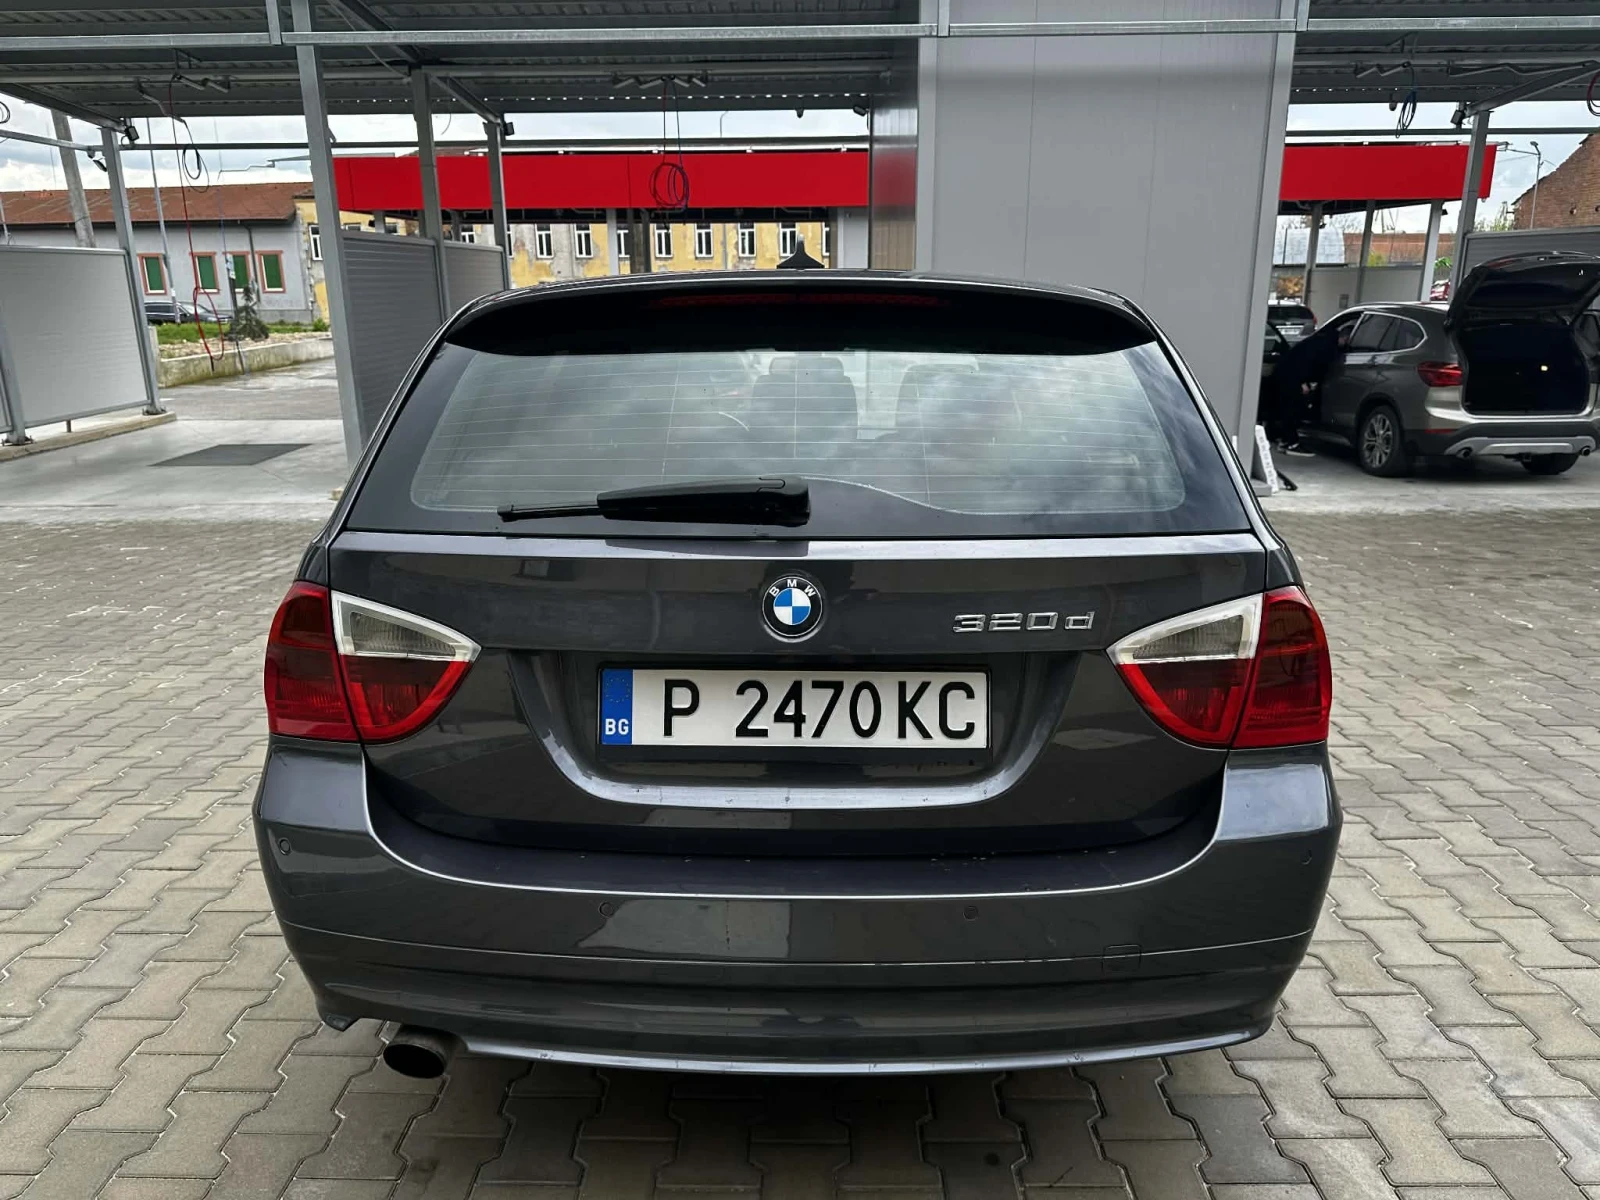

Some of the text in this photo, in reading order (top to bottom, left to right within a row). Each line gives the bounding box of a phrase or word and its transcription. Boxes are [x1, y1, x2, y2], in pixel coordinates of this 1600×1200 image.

[769, 579, 816, 597] BMW
[952, 611, 1095, 632] 320d
[663, 678, 975, 739] P 2470 KC
[605, 718, 629, 735] BG
